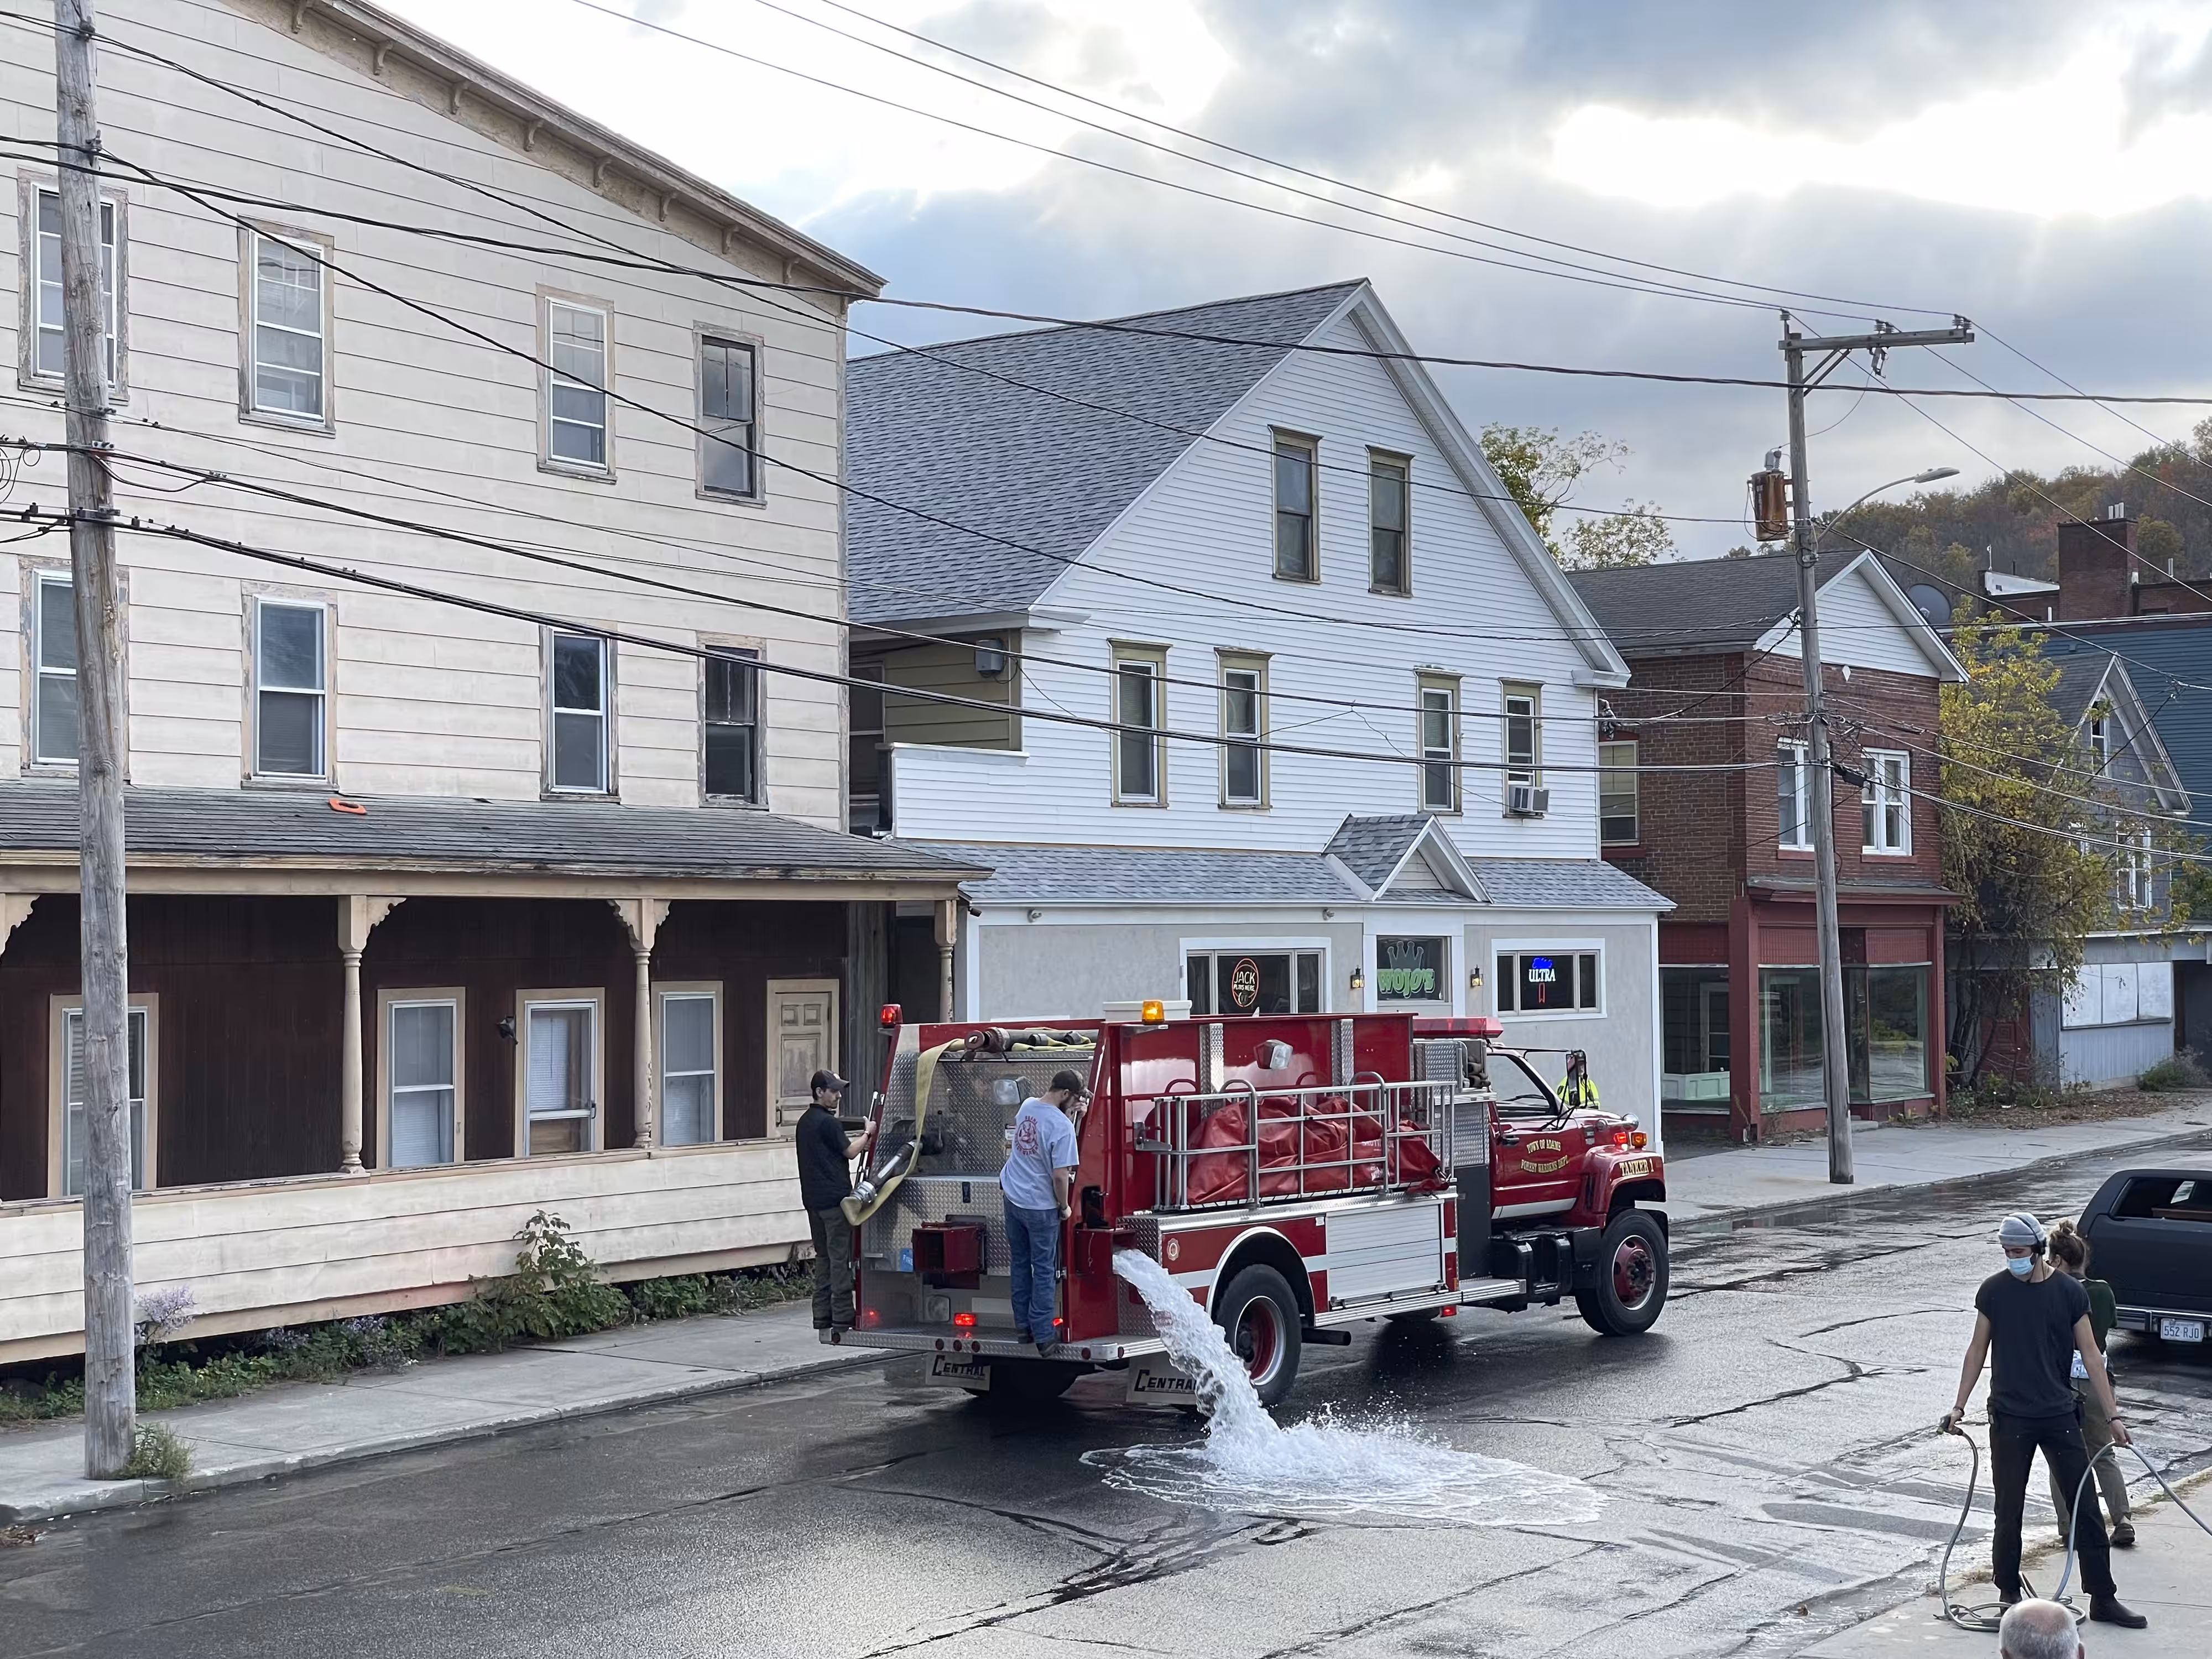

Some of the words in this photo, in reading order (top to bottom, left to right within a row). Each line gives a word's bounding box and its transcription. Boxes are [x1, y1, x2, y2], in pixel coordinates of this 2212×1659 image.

[1234, 971, 1255, 984] JACK
[1528, 968, 1556, 982] ULTRA
[1526, 1140, 1539, 1154] TOWN
[1539, 1139, 1546, 1149] OF
[1546, 1139, 1561, 1151] ADAMS
[1521, 1159, 1537, 1173] FOREST
[1619, 1159, 1649, 1176] TANKER
[1649, 1158, 1654, 1172] 1
[2164, 1326, 2180, 1337] 552
[932, 1355, 985, 1376] CENTRAL
